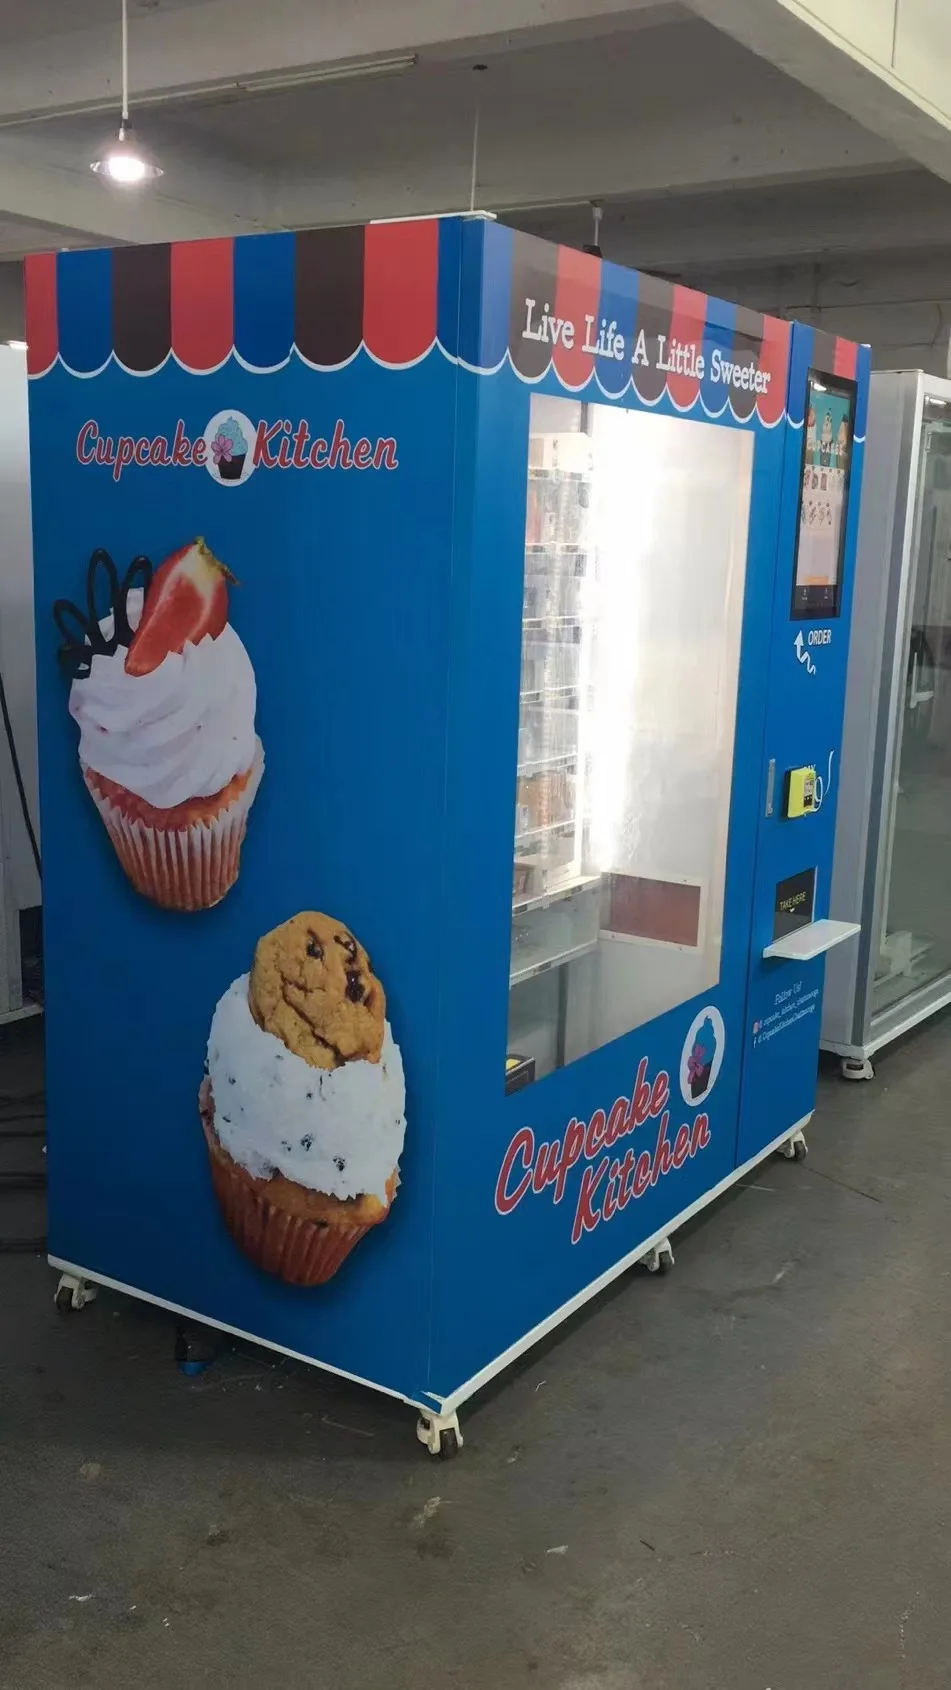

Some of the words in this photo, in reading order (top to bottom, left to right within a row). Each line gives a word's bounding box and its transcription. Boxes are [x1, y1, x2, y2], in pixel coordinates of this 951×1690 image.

[522, 298, 575, 349] Live
[582, 314, 625, 360] Life
[631, 328, 649, 367] A
[656, 334, 705, 380] Little
[710, 349, 771, 394] Sweeter
[76, 419, 208, 482] Cupcake
[252, 419, 399, 469] Kitchen
[808, 629, 832, 645] ORDER
[780, 897, 793, 910] TAKE
[793, 891, 807, 905] HERE
[495, 1056, 669, 1215] Cupcake
[571, 1110, 711, 1245] Kitchen
